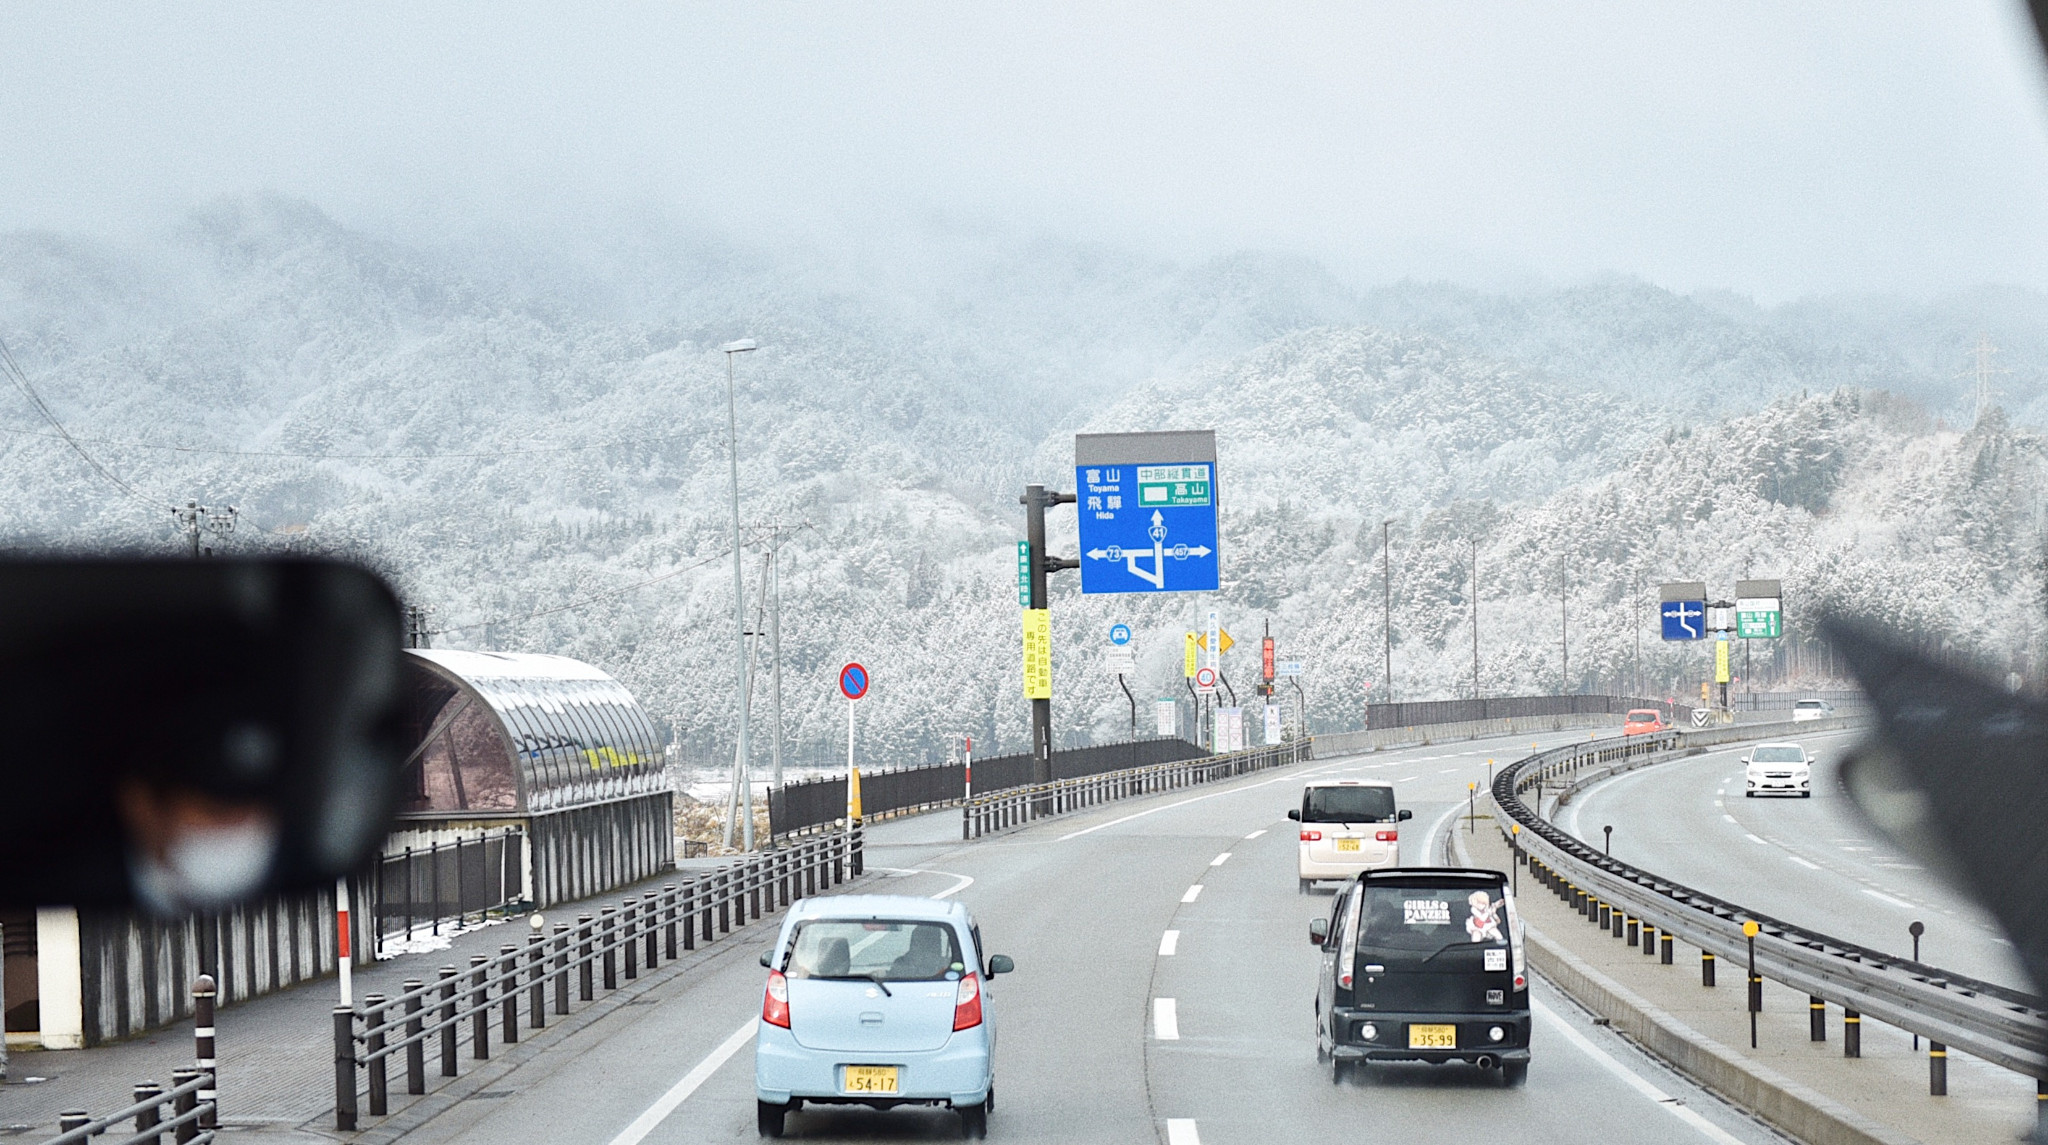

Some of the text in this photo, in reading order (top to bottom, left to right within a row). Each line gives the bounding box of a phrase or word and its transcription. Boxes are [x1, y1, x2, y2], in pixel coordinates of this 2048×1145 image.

[1085, 468, 1120, 483] 富山
[1140, 467, 1206, 480] 中部縦貫道
[1088, 484, 1120, 494] Toyama
[1174, 483, 1204, 495] 高山
[1172, 496, 1208, 504] Takayama
[1096, 511, 1115, 519] Hida
[1152, 528, 1164, 538] 41
[1109, 549, 1120, 558] 73
[1174, 547, 1188, 556] 457
[1037, 612, 1048, 688] この先は自動車
[1201, 673, 1212, 683] 40
[1403, 900, 1439, 910] GIRLS
[1404, 910, 1451, 920] PANZER
[1420, 1034, 1453, 1046] 35-99
[856, 1077, 894, 1091] 54-17
